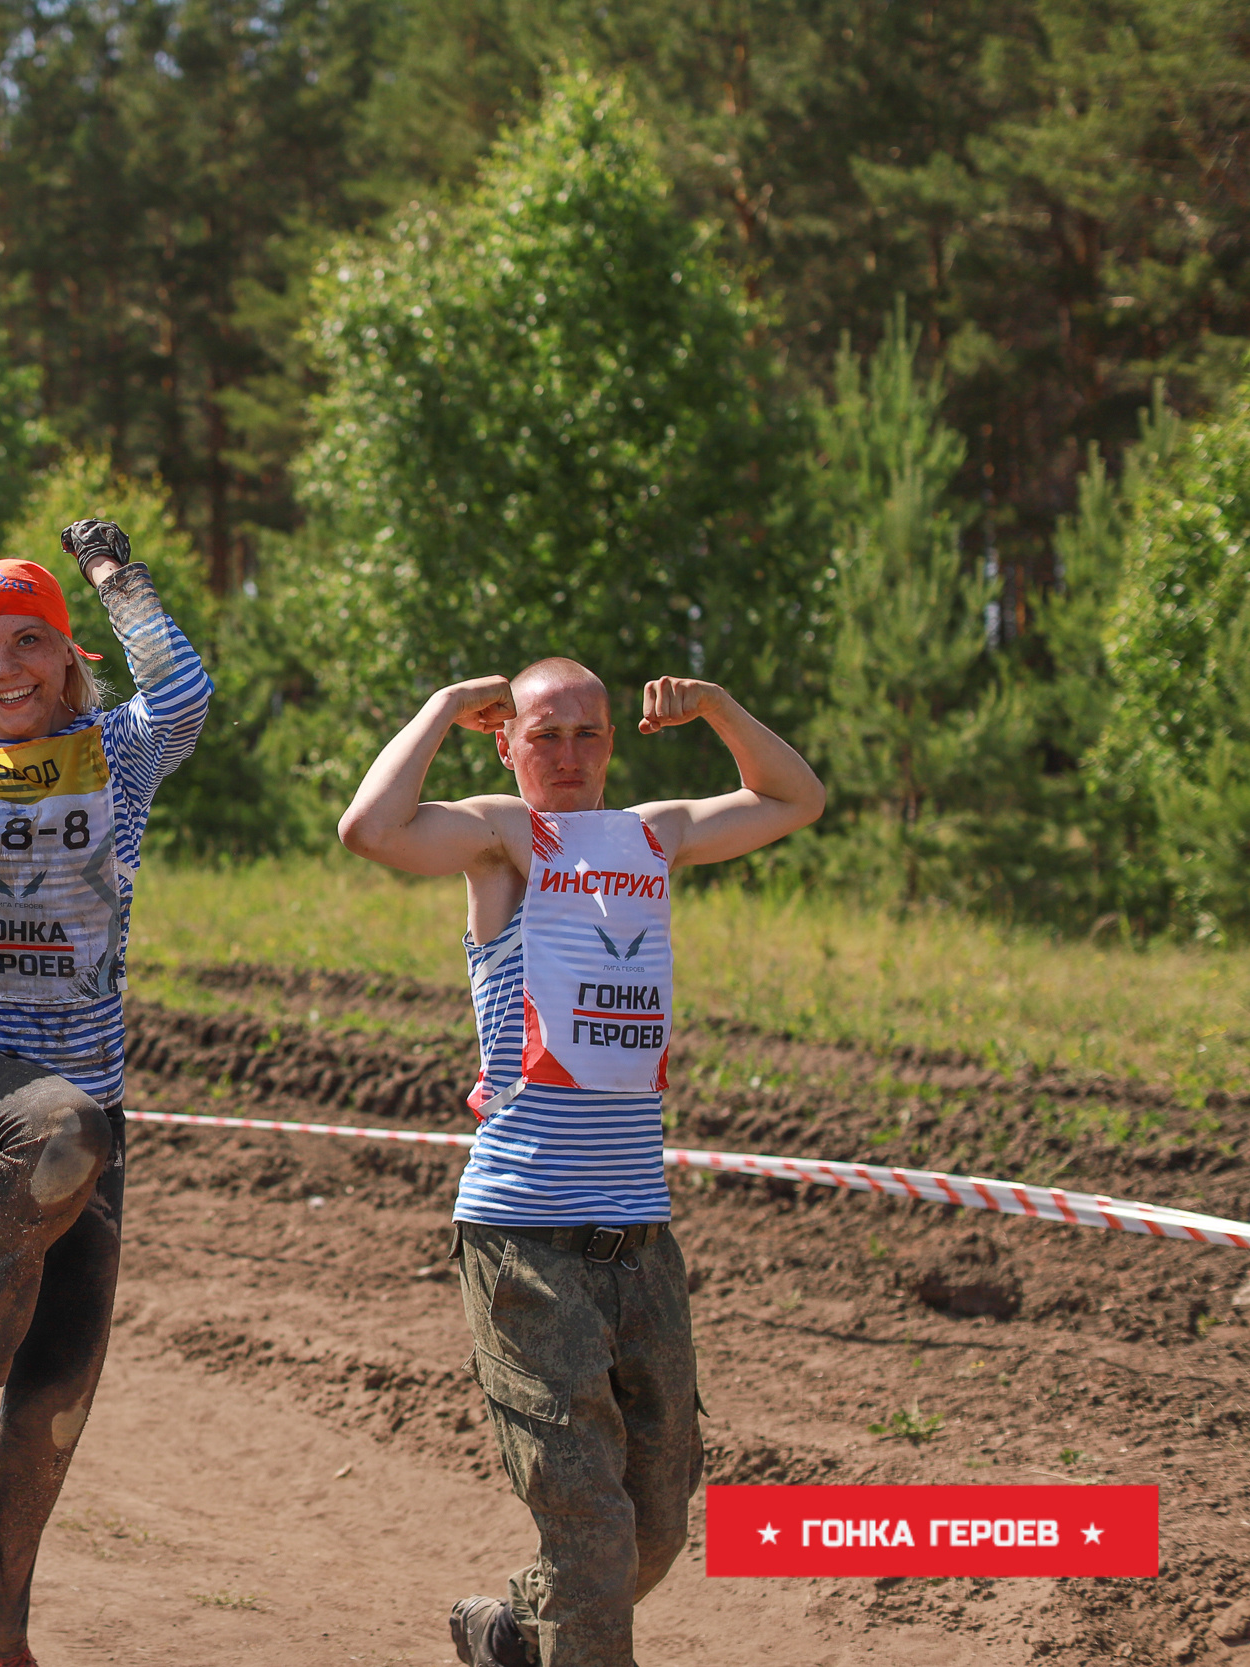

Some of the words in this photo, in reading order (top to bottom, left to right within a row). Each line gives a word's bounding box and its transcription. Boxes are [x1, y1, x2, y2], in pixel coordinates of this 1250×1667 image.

[622, 965, 645, 973] ГЕРОЕВ
[578, 982, 660, 1010] ГОНКА
[572, 1020, 664, 1049] ГЕРОЕВ
